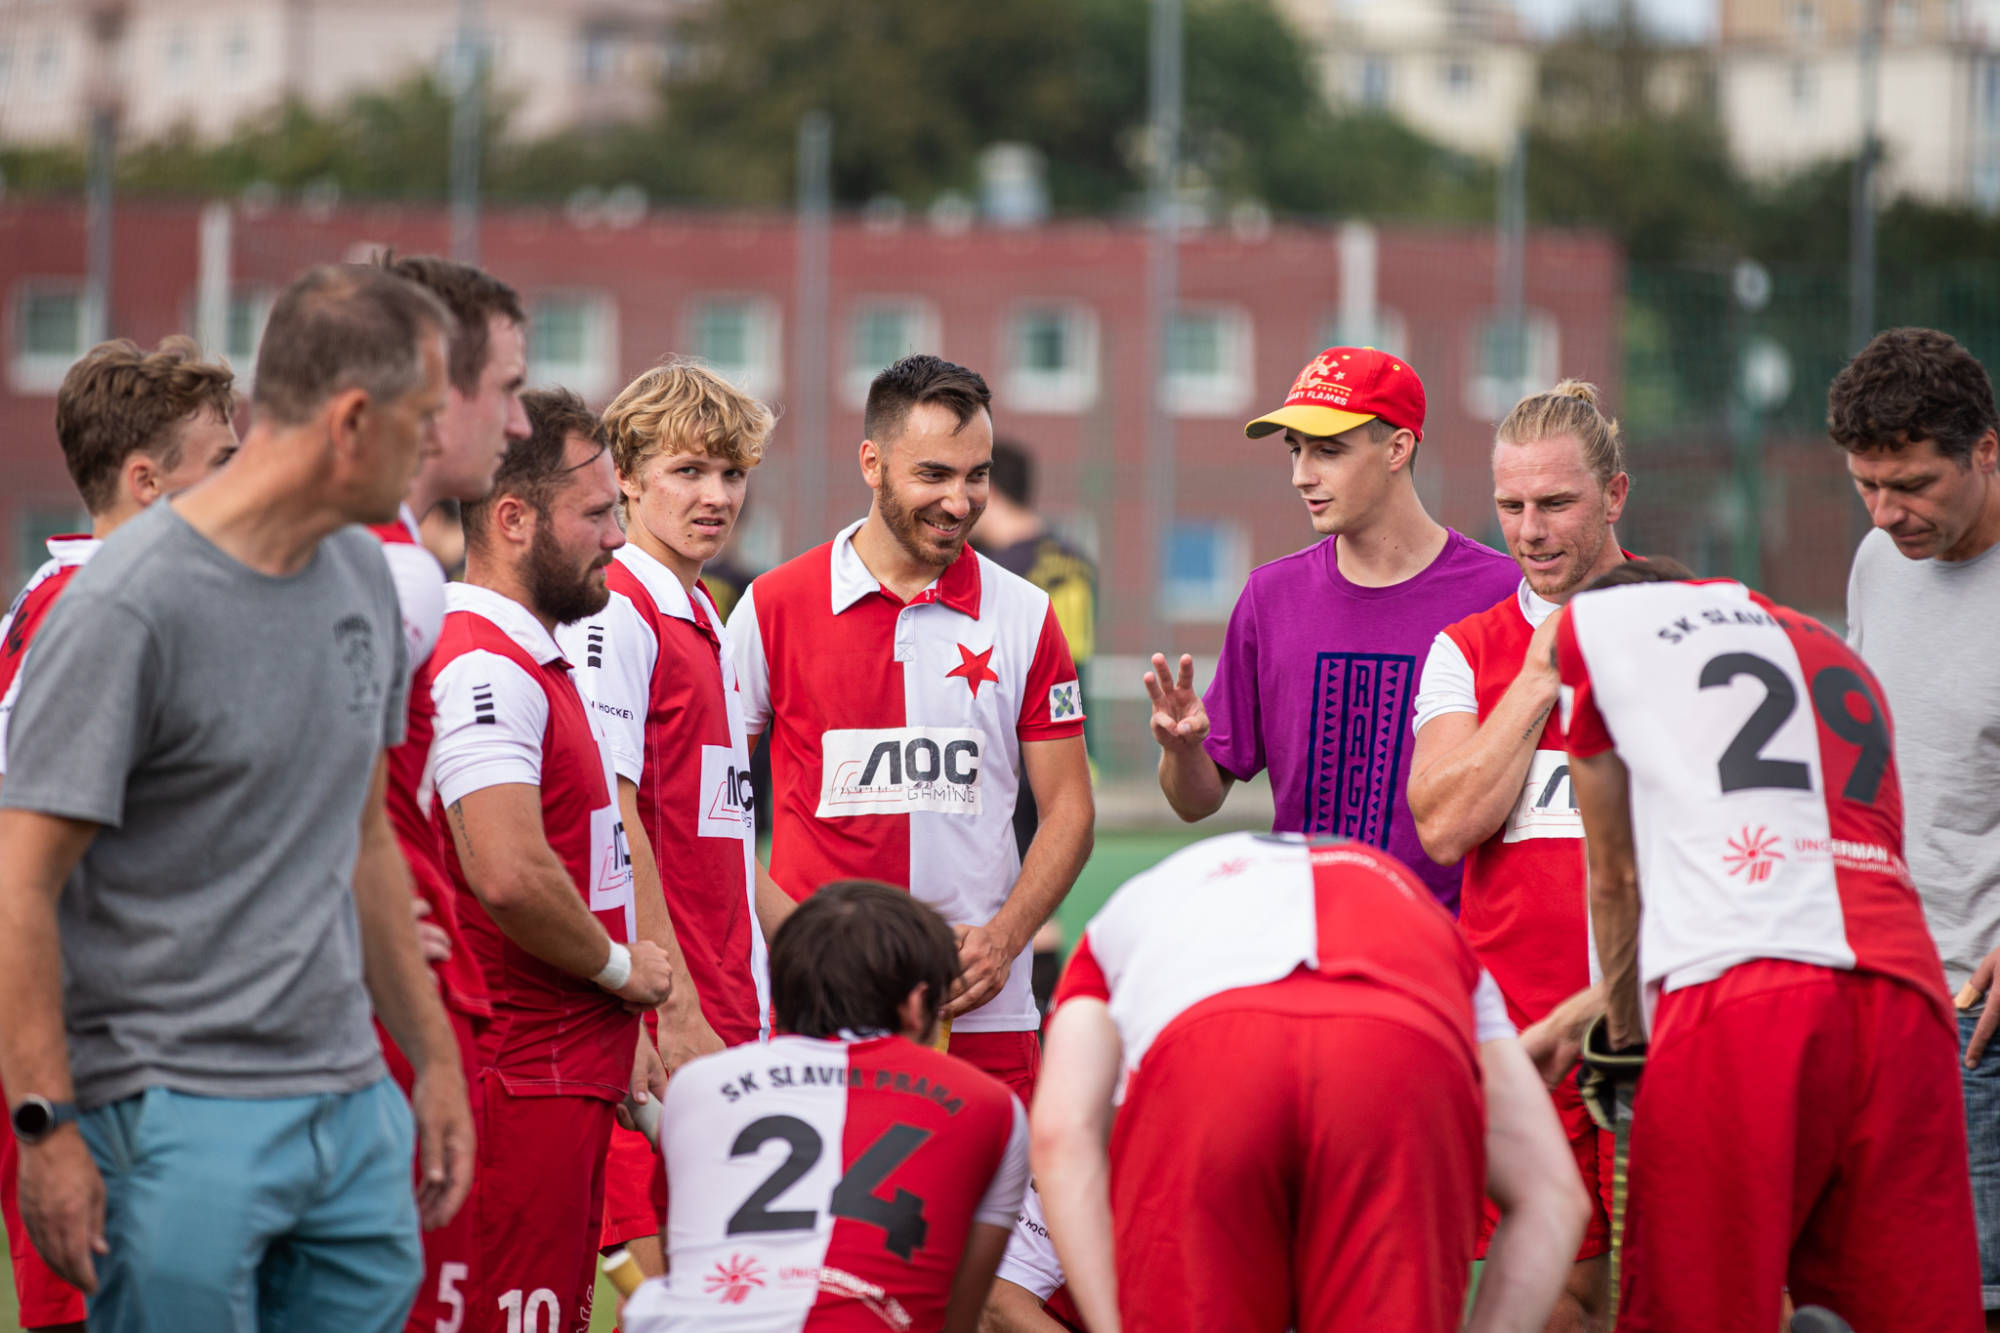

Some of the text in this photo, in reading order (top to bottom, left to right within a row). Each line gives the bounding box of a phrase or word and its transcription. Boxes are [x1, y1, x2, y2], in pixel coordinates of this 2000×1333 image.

[1307, 391, 1348, 405] FLAMES
[1658, 617, 1697, 644] SK
[1699, 652, 1890, 805] 29
[859, 738, 979, 786] AOC
[721, 1066, 964, 1116] SK SLAVIA PRAHA
[726, 1115, 932, 1263] 24
[435, 1261, 469, 1333] 5
[498, 1288, 561, 1333] 10
